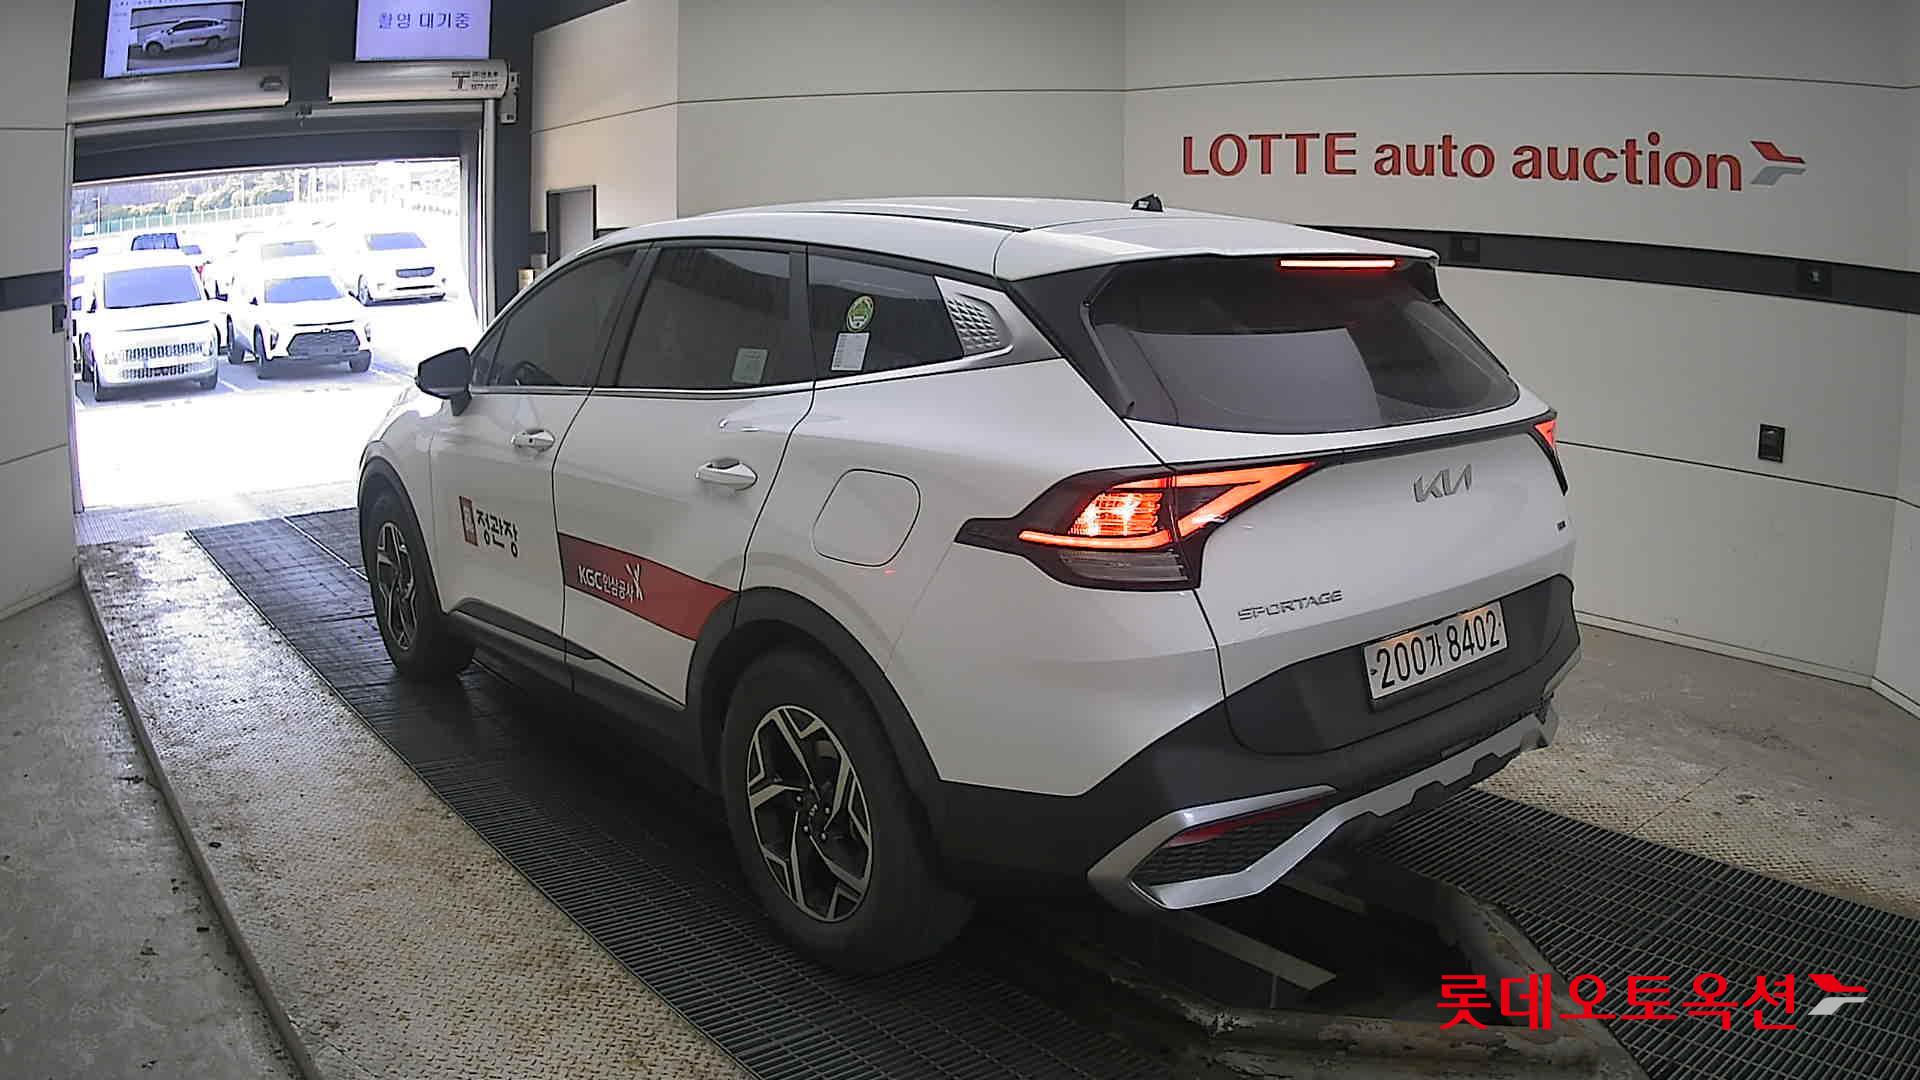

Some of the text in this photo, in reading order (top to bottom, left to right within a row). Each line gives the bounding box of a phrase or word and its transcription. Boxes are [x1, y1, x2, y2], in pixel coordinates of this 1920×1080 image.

[418, 12, 471, 29] 대기중
[1183, 131, 1743, 192] LOTTE auto auction
[476, 508, 519, 557] 정관장
[1238, 590, 1344, 621] SPORTAGE
